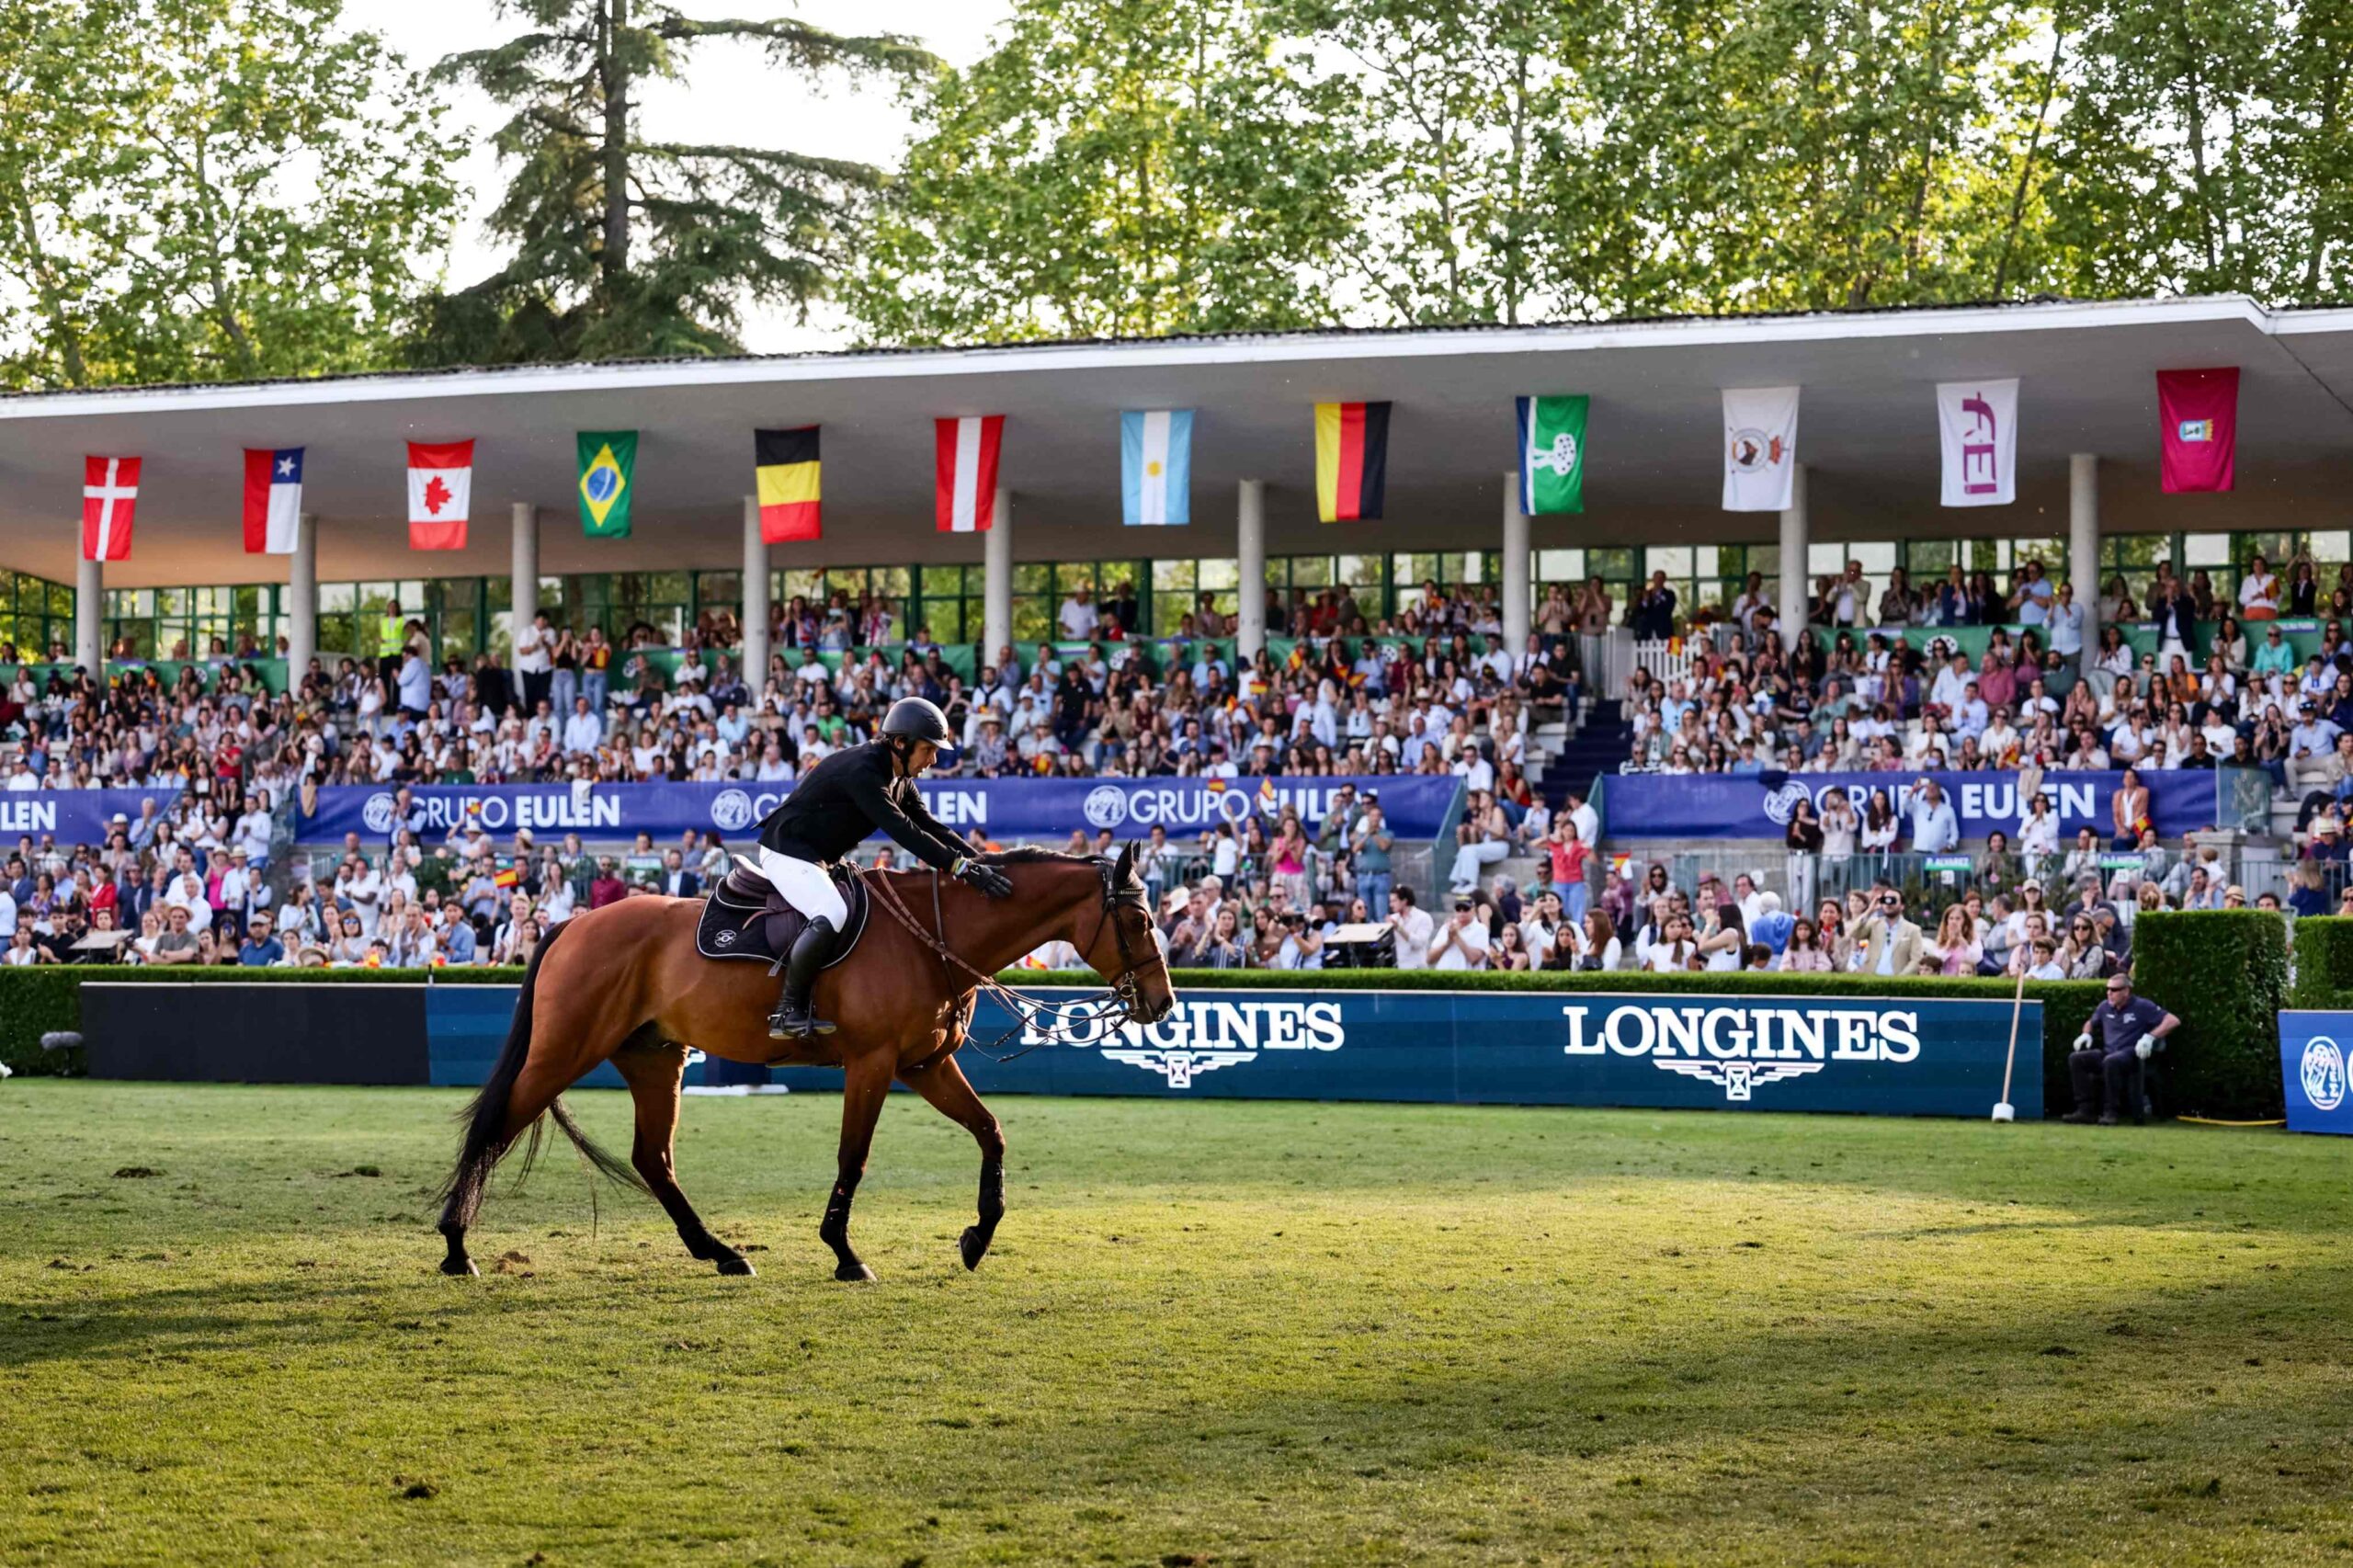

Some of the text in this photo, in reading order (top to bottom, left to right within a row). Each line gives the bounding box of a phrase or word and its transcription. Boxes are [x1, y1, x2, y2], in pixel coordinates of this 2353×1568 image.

[920, 791, 987, 824] LEN
[1129, 788, 1379, 824] GRUPO EUL
[1017, 999, 1345, 1051] LONGINES
[1563, 1006, 1921, 1062] LONGINES
